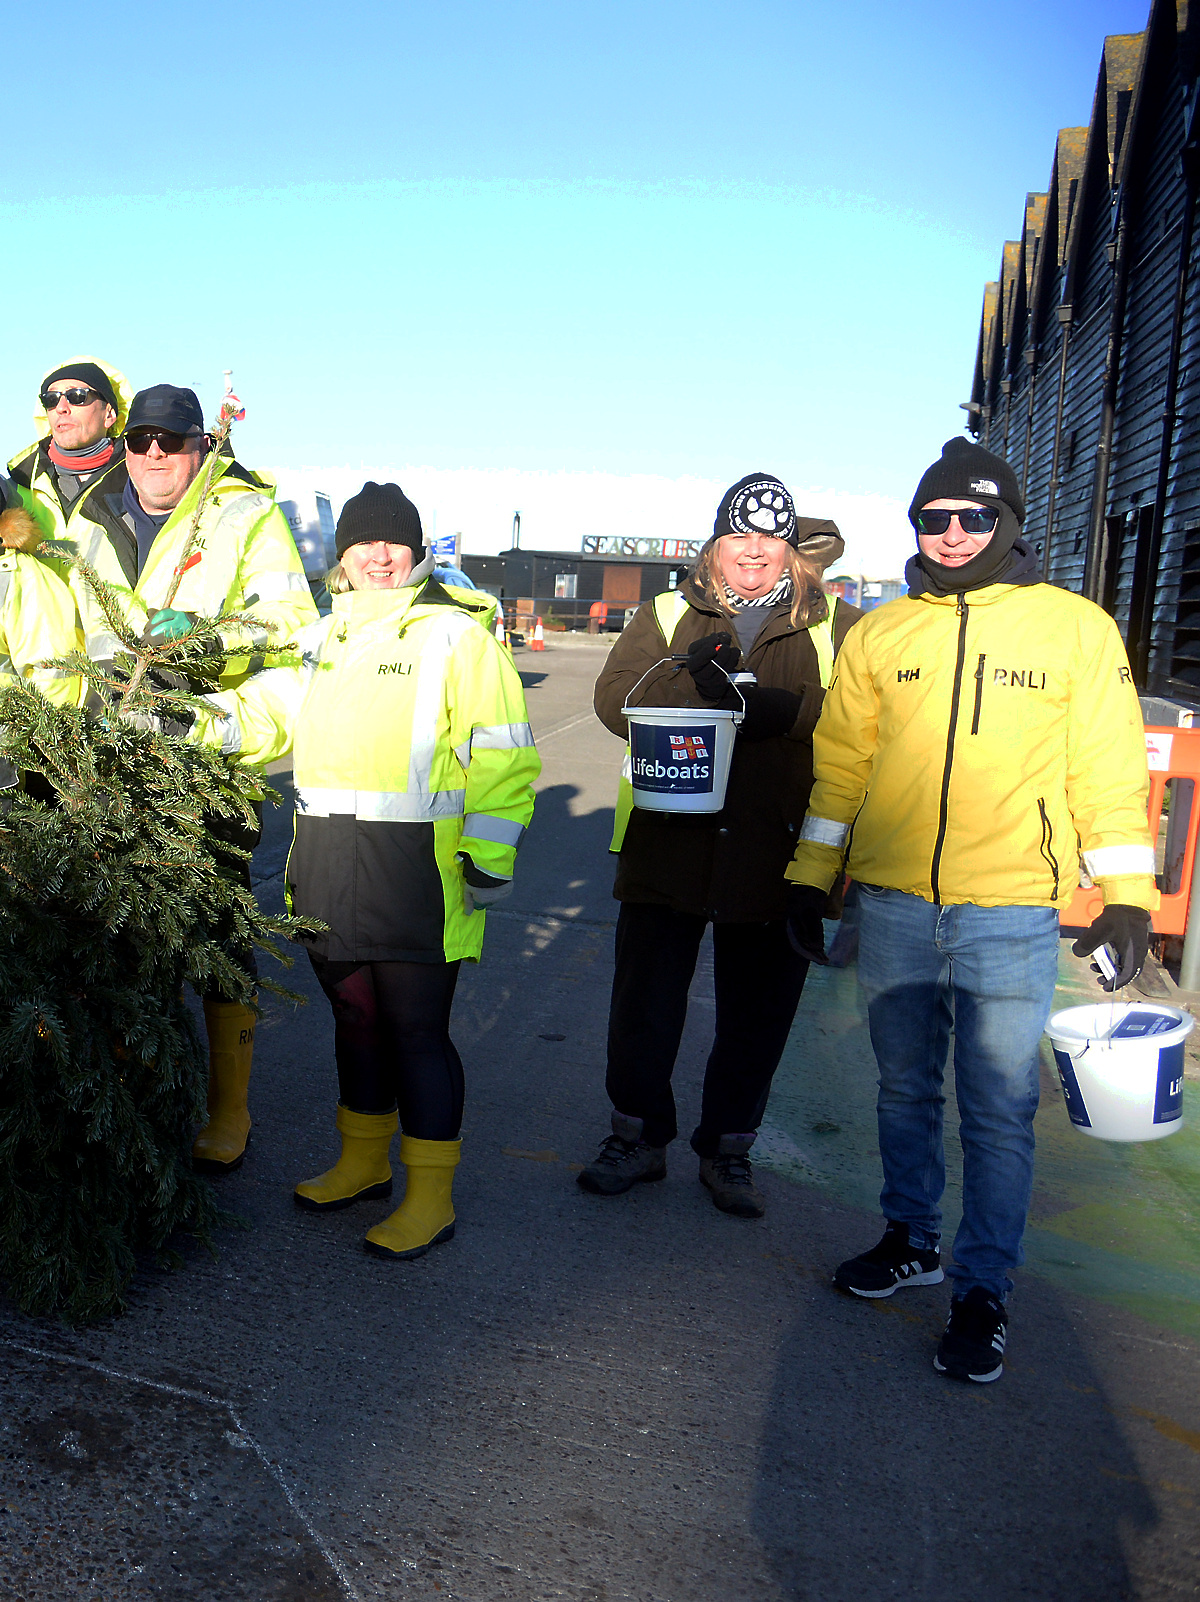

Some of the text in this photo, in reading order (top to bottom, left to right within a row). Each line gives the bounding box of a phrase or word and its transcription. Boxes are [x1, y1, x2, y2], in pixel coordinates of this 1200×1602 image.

[584, 536, 700, 558] SEASCRUBS
[377, 662, 412, 675] RNLI
[897, 668, 1046, 690] HH RNLI
[632, 756, 709, 779] Lifeboats
